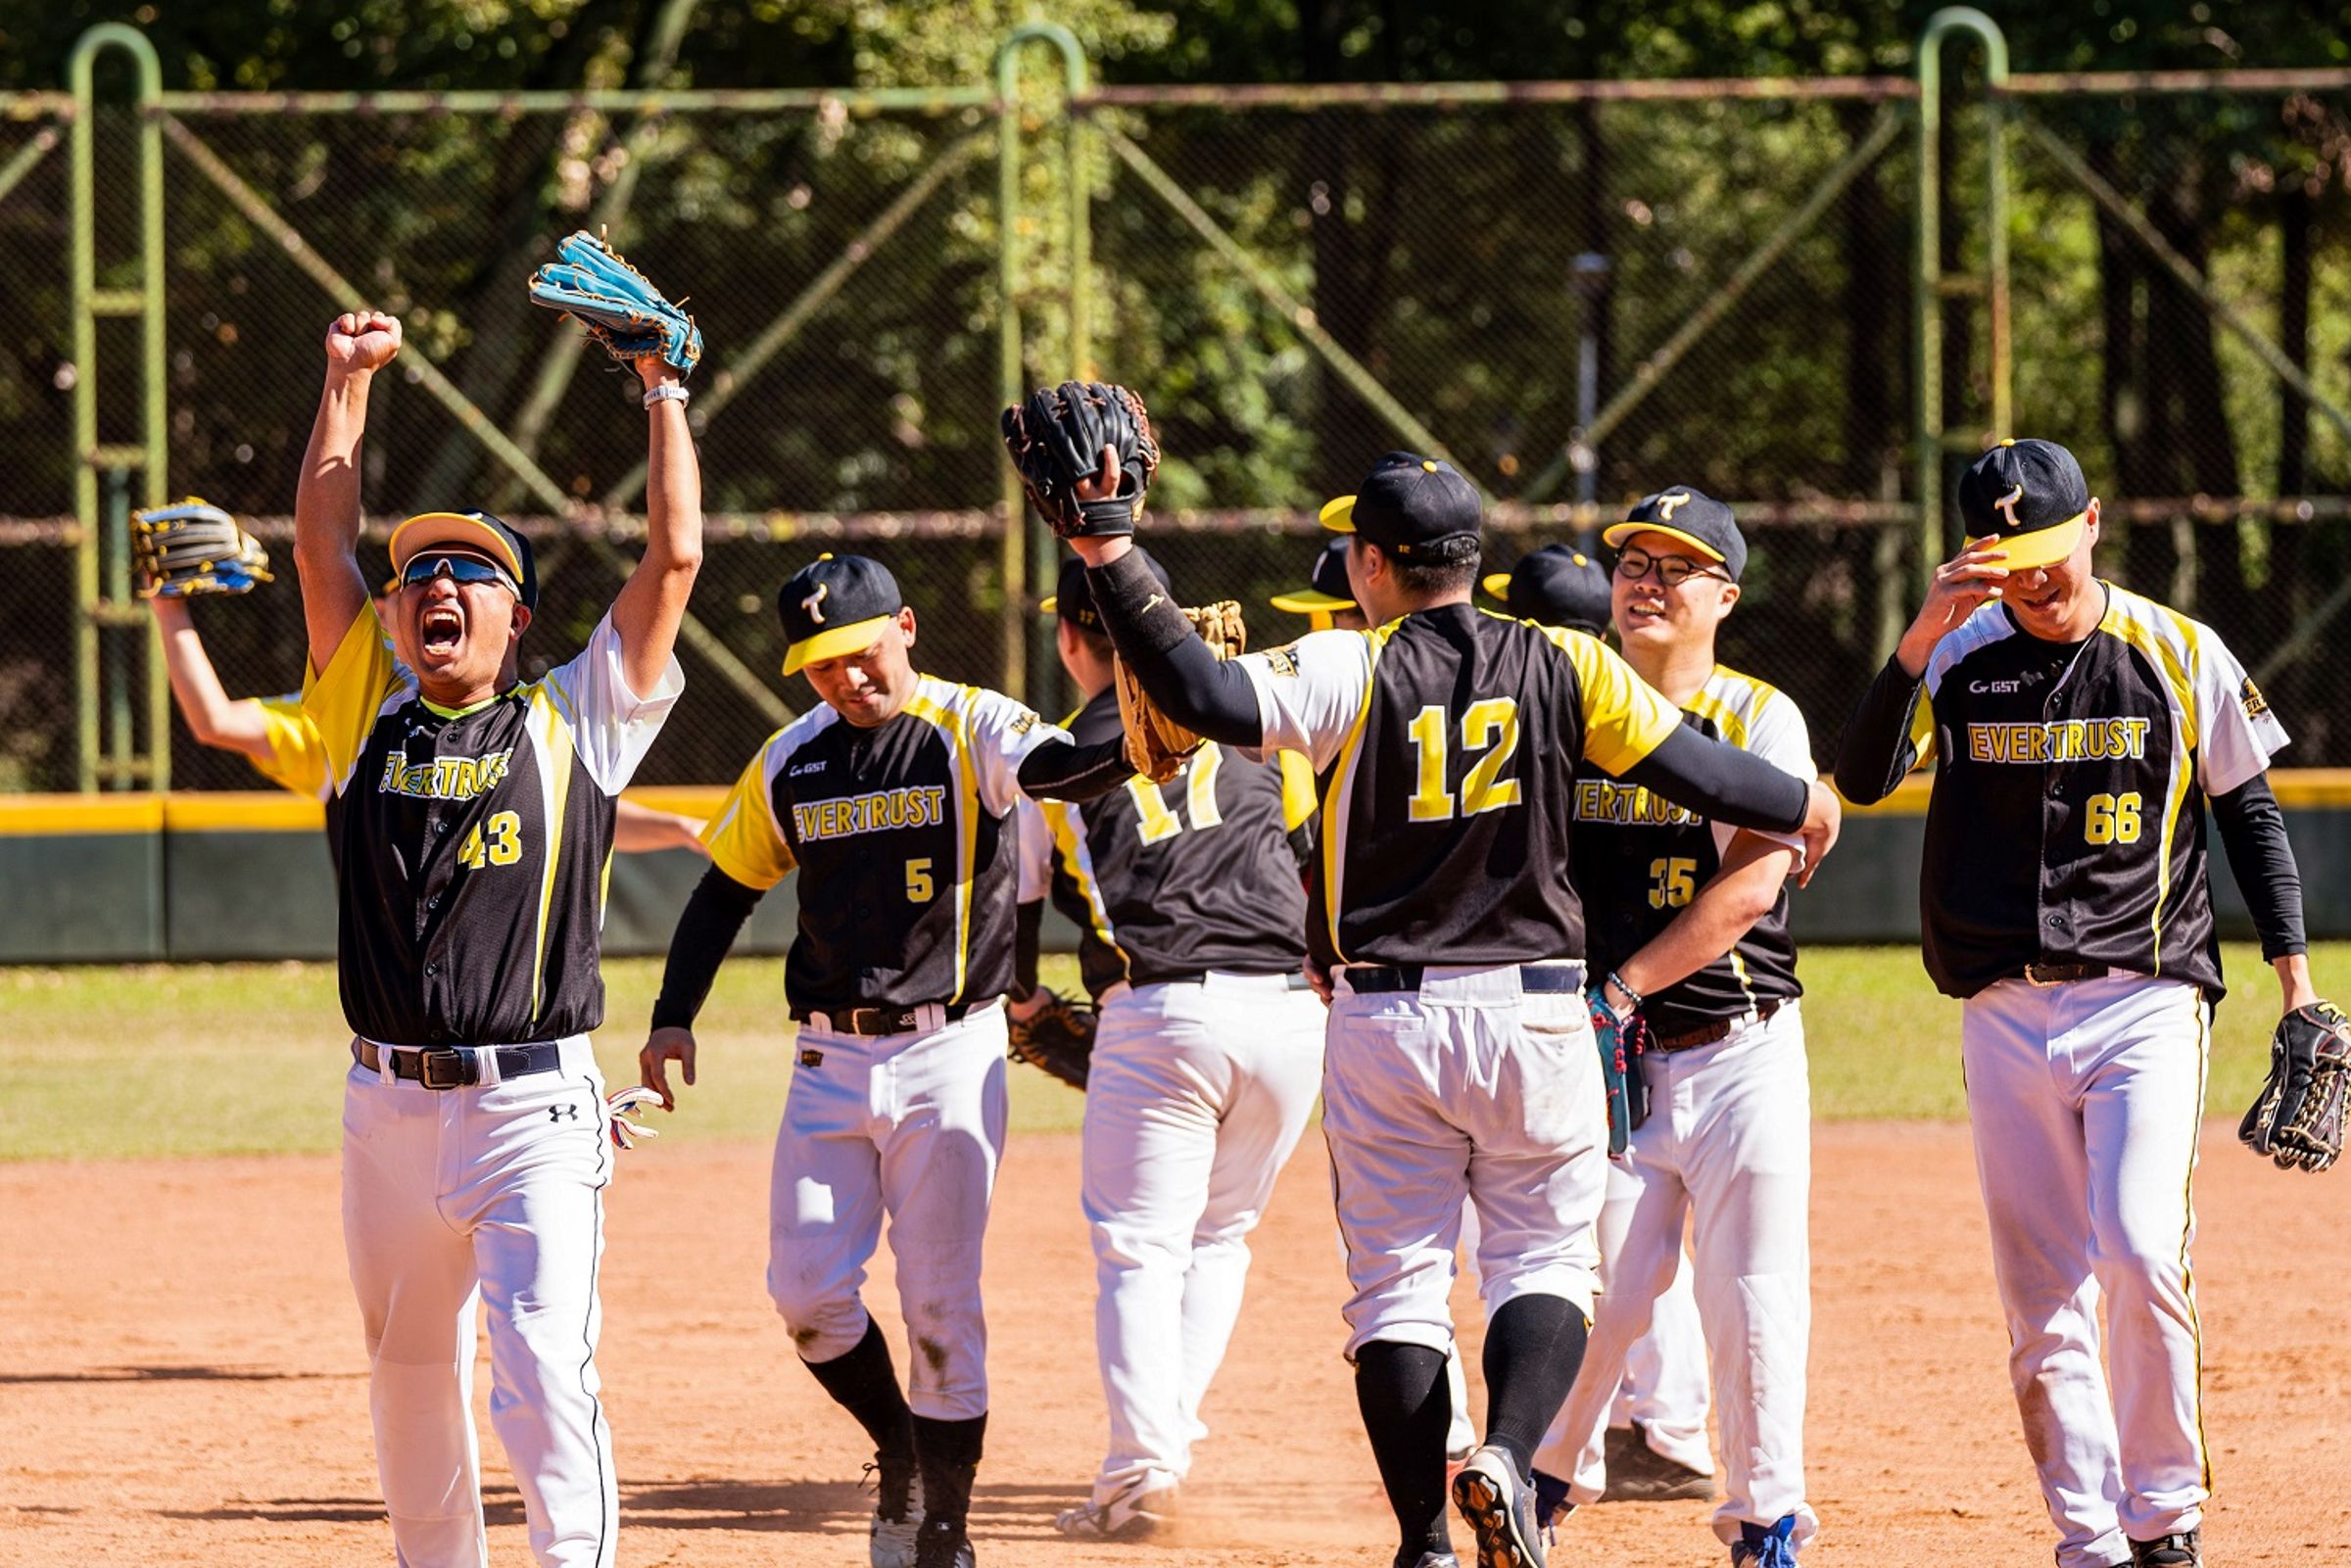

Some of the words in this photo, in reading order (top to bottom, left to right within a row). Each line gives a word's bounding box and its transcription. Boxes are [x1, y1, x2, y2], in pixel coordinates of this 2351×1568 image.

[1408, 695, 1522, 822] 12
[1967, 716, 2151, 764] EVERTRUST
[1122, 737, 1223, 847] 17
[2084, 791, 2142, 845] 66
[457, 810, 522, 870] 43
[905, 857, 934, 903] 5
[1648, 857, 1698, 910] 35
